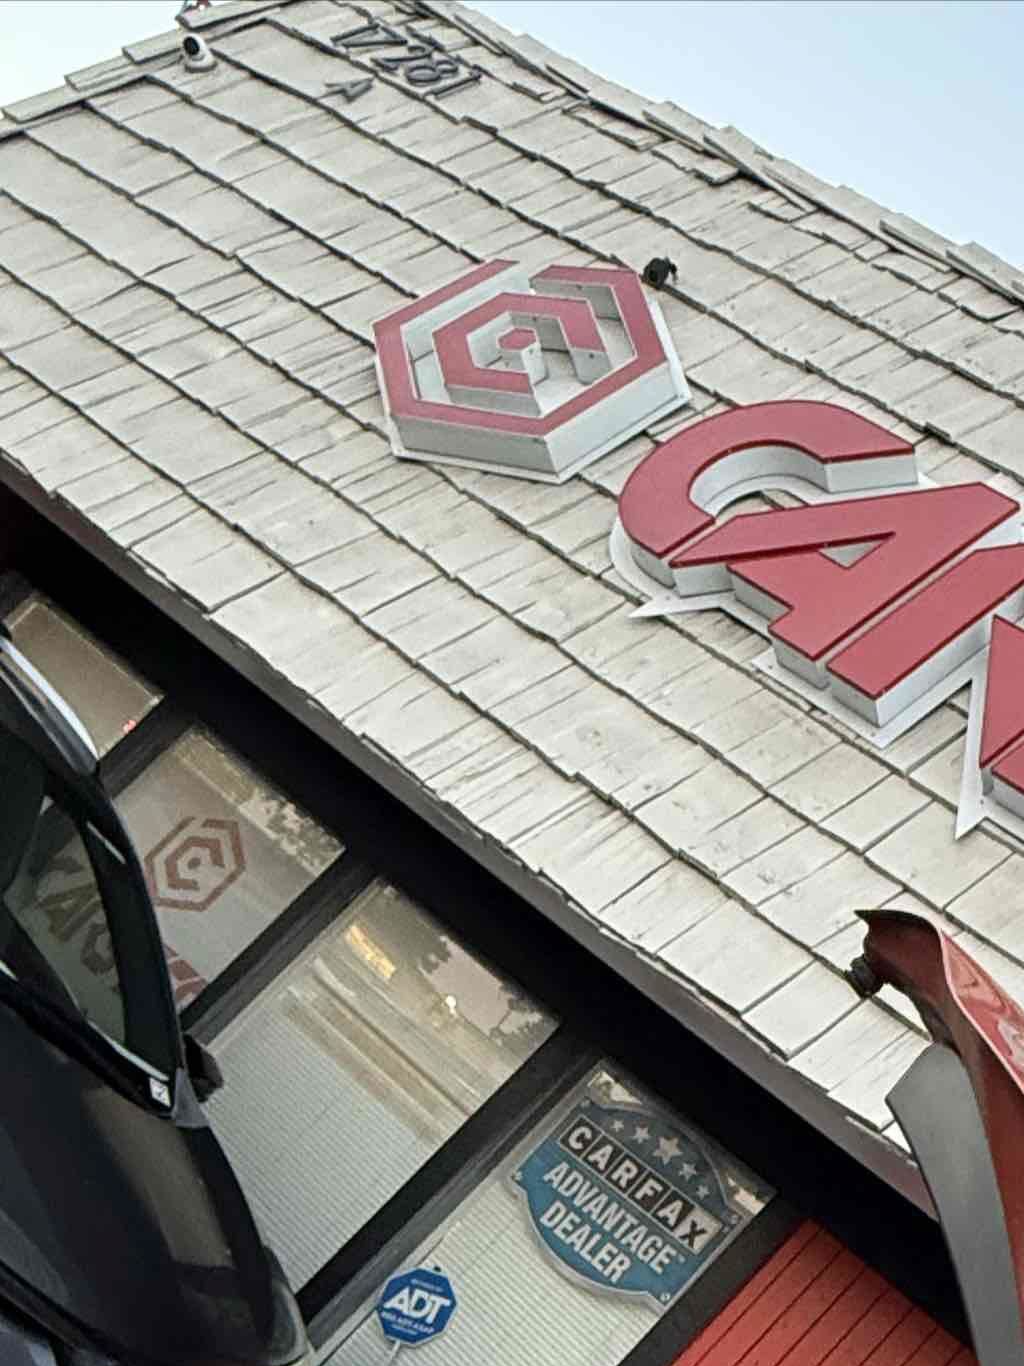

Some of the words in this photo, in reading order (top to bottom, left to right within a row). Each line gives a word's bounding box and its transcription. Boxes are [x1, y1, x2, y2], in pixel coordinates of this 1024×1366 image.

[329, 23, 483, 100] 17281
[542, 1160, 679, 1275] ADVANTAGE
[565, 1123, 712, 1251] CARFAX
[539, 1200, 632, 1284] DEALER
[383, 1285, 451, 1325] ADT
